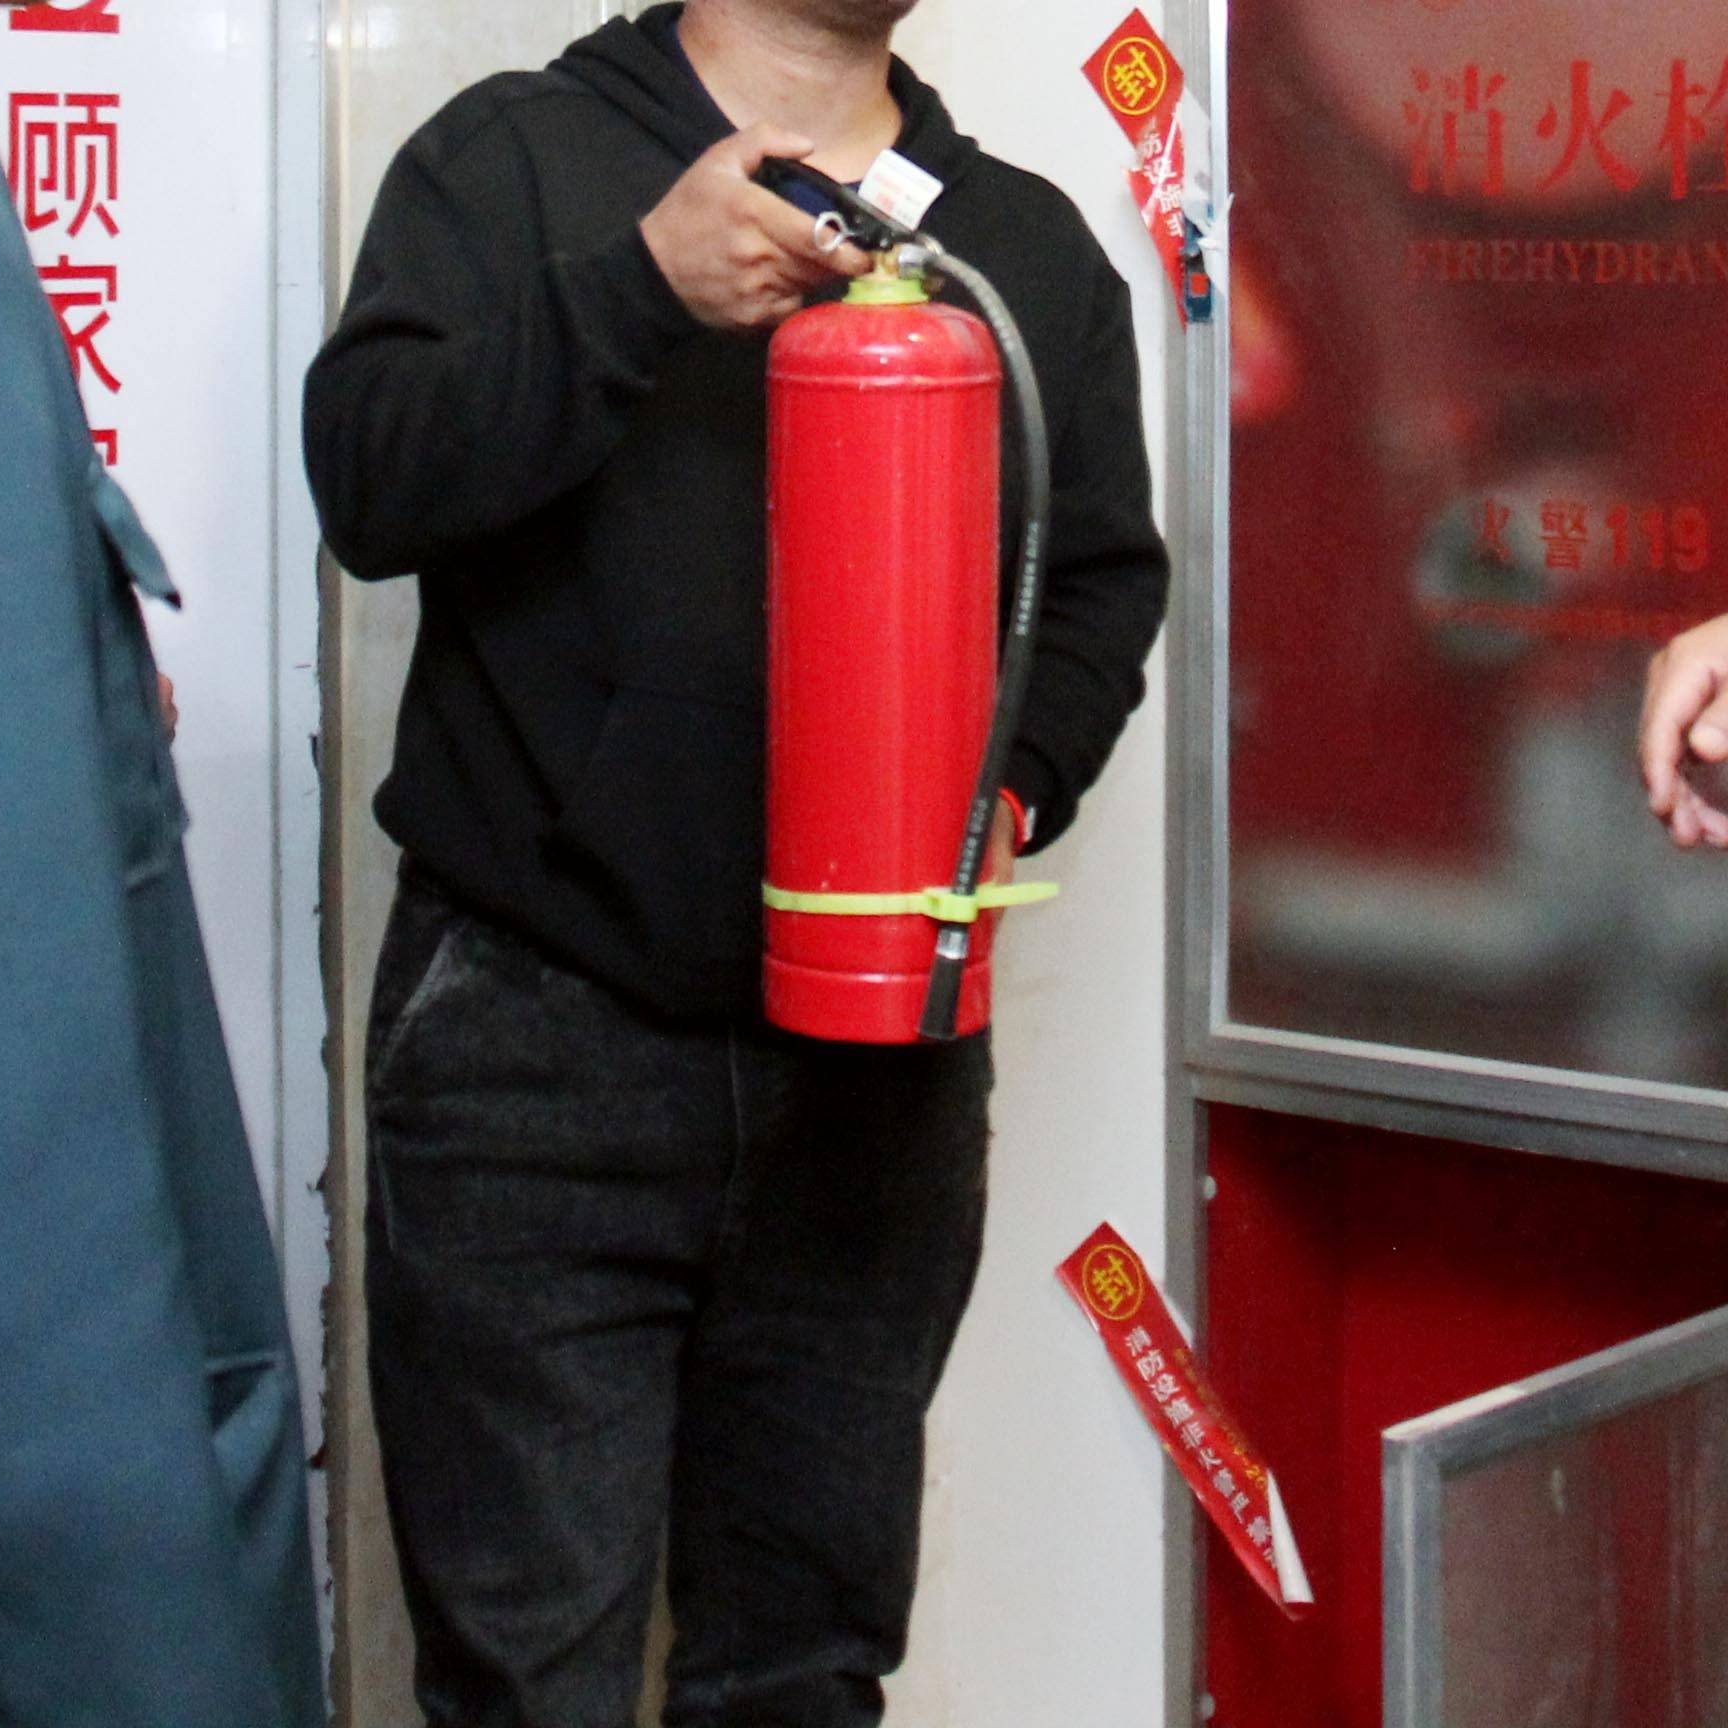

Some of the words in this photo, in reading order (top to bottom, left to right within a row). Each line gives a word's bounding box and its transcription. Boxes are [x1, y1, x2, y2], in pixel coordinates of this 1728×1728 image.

[1112, 45, 1159, 108] 封
[8, 92, 121, 467] 顾家
[1092, 1253, 1136, 1312] 封
